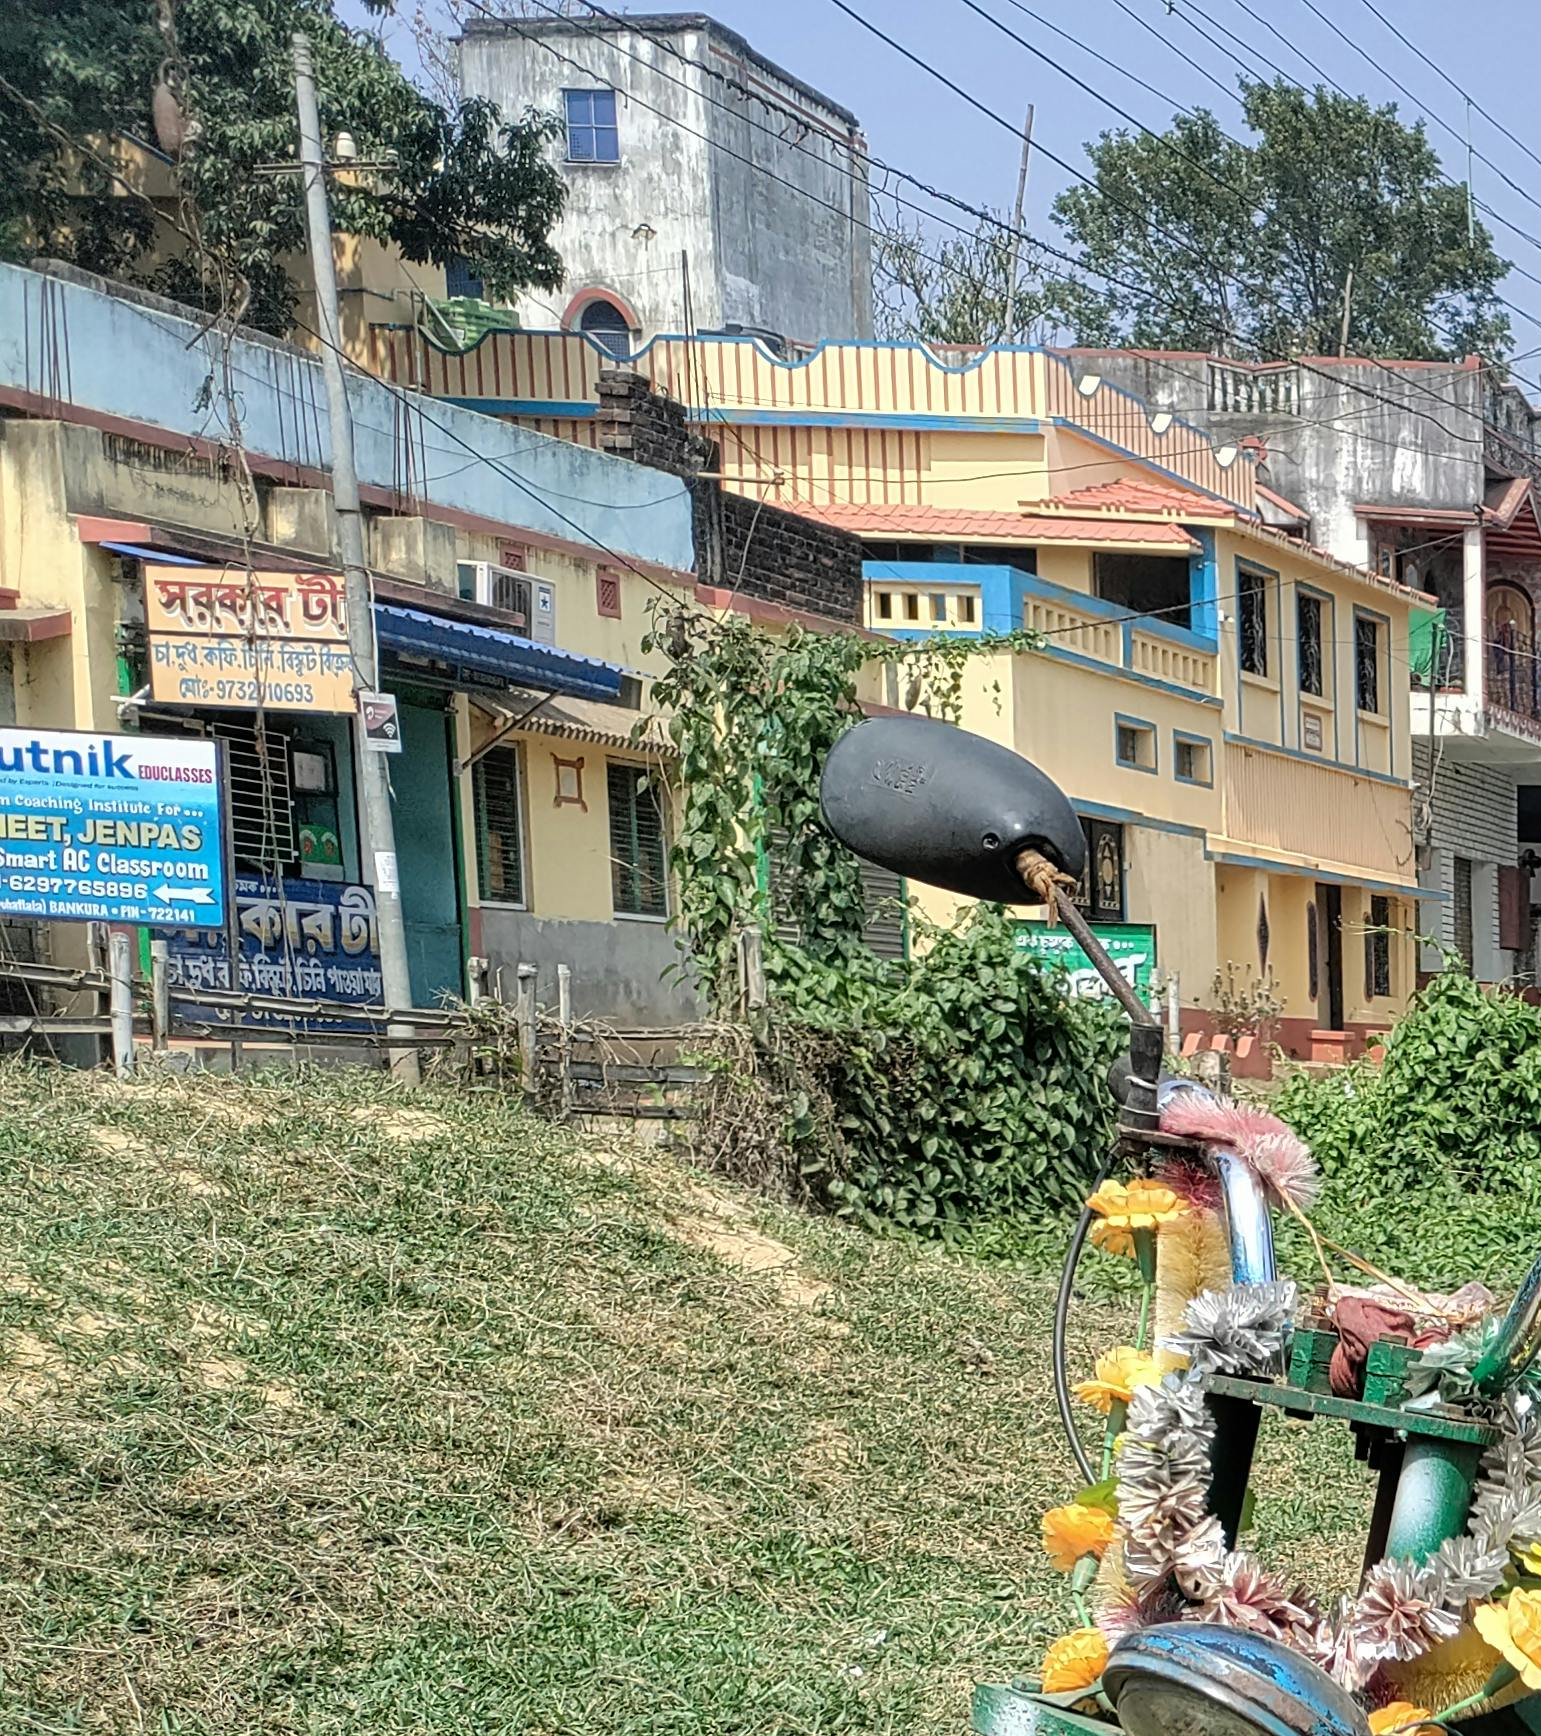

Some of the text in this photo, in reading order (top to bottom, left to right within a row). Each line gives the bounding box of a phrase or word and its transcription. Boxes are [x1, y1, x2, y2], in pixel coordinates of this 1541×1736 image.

[154, 580, 291, 630] সরকার
[138, 765, 213, 784] EDUCLASSES
[15, 795, 83, 815] Coaching
[89, 799, 150, 815] Institute
[77, 819, 203, 851] JENPAS
[63, 848, 91, 873] AC
[97, 852, 209, 880] Classroom
[49, 900, 109, 917] BANKURA
